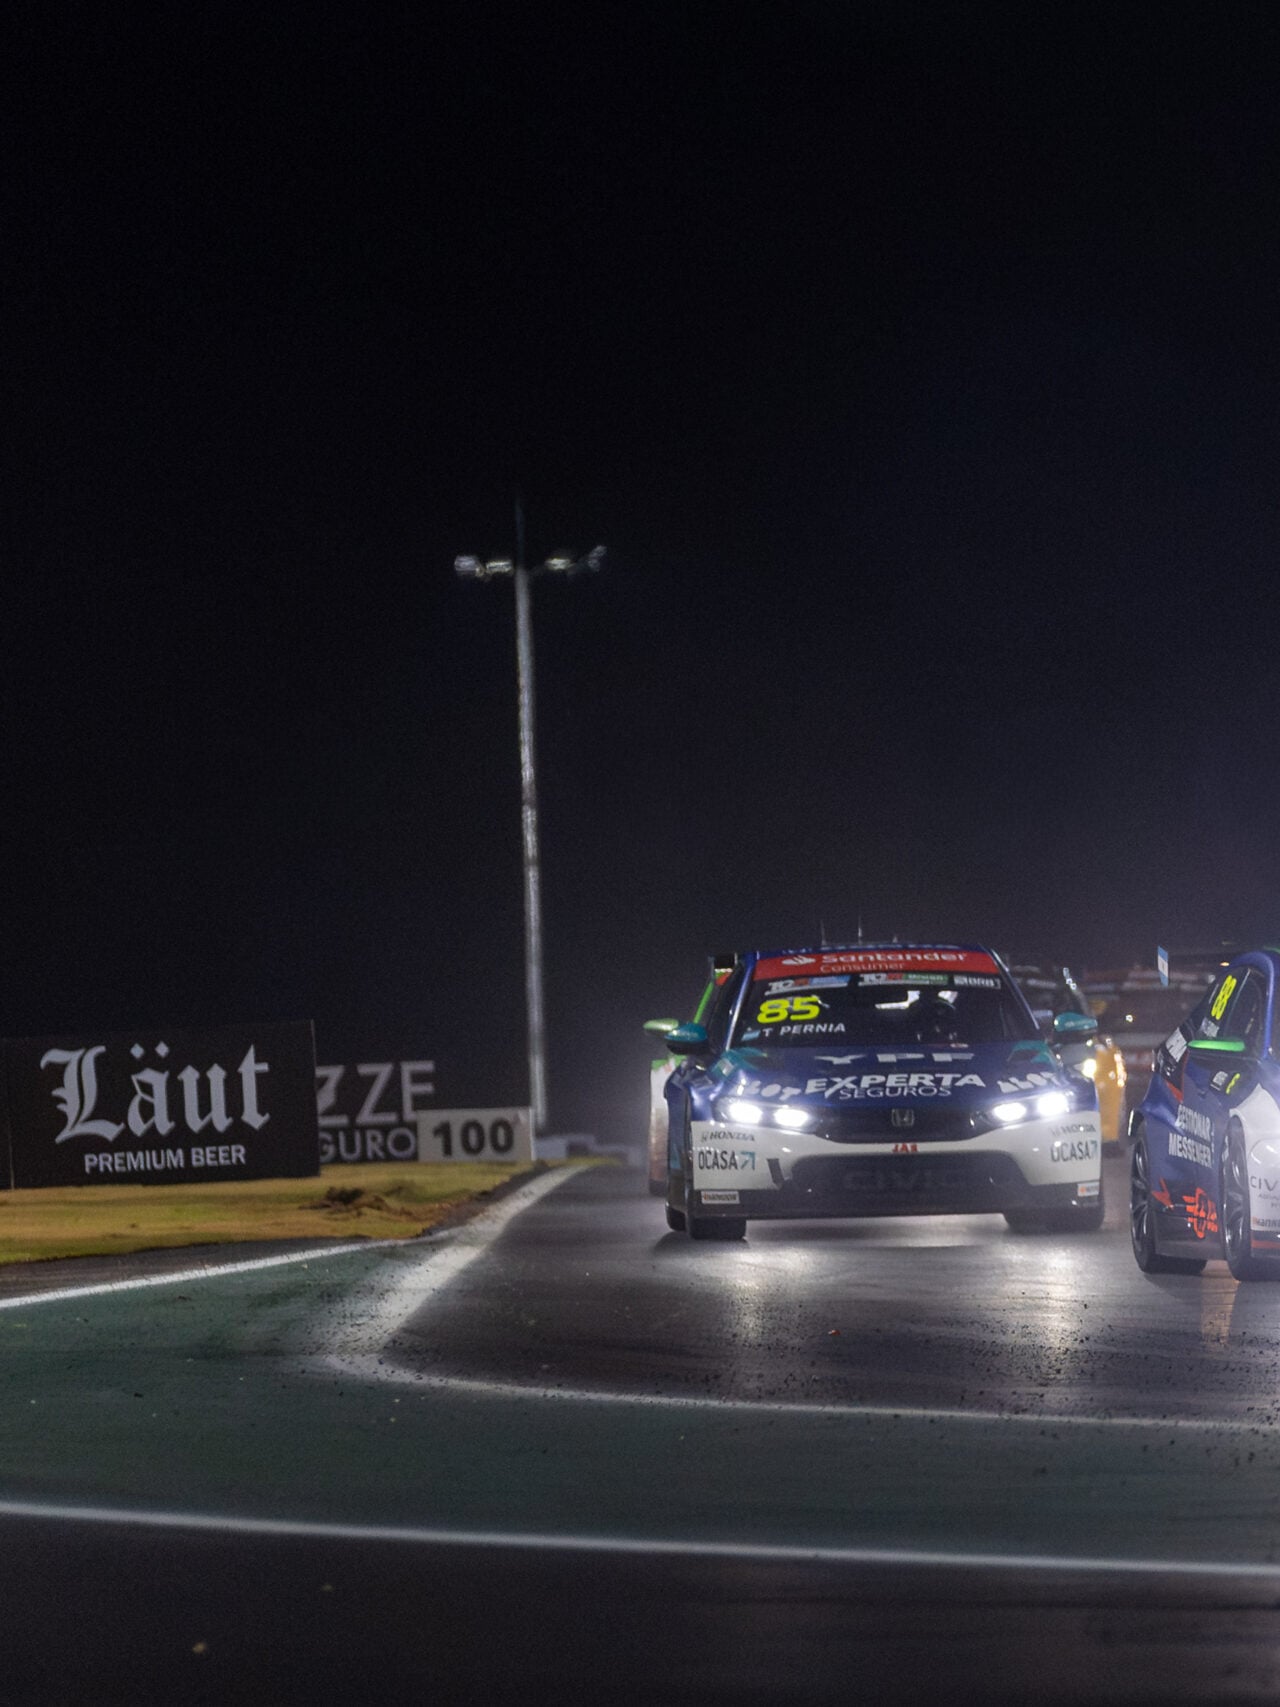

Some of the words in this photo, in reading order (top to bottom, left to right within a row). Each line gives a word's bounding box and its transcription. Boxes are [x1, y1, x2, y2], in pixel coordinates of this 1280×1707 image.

[820, 963, 906, 973] Consumer
[821, 952, 967, 963] Santander
[757, 996, 820, 1023] 85
[779, 1022, 846, 1036] PERNIA
[814, 1052, 975, 1065] YPF
[40, 1041, 270, 1144] Läut
[805, 1073, 986, 1098] EXPERTA
[839, 1086, 951, 1100] SEGUROS
[319, 1127, 416, 1163] GURO
[433, 1118, 514, 1157] 100
[84, 1148, 185, 1175] PREMIUM
[191, 1144, 246, 1168] BEER
[698, 1149, 738, 1170] OCASA
